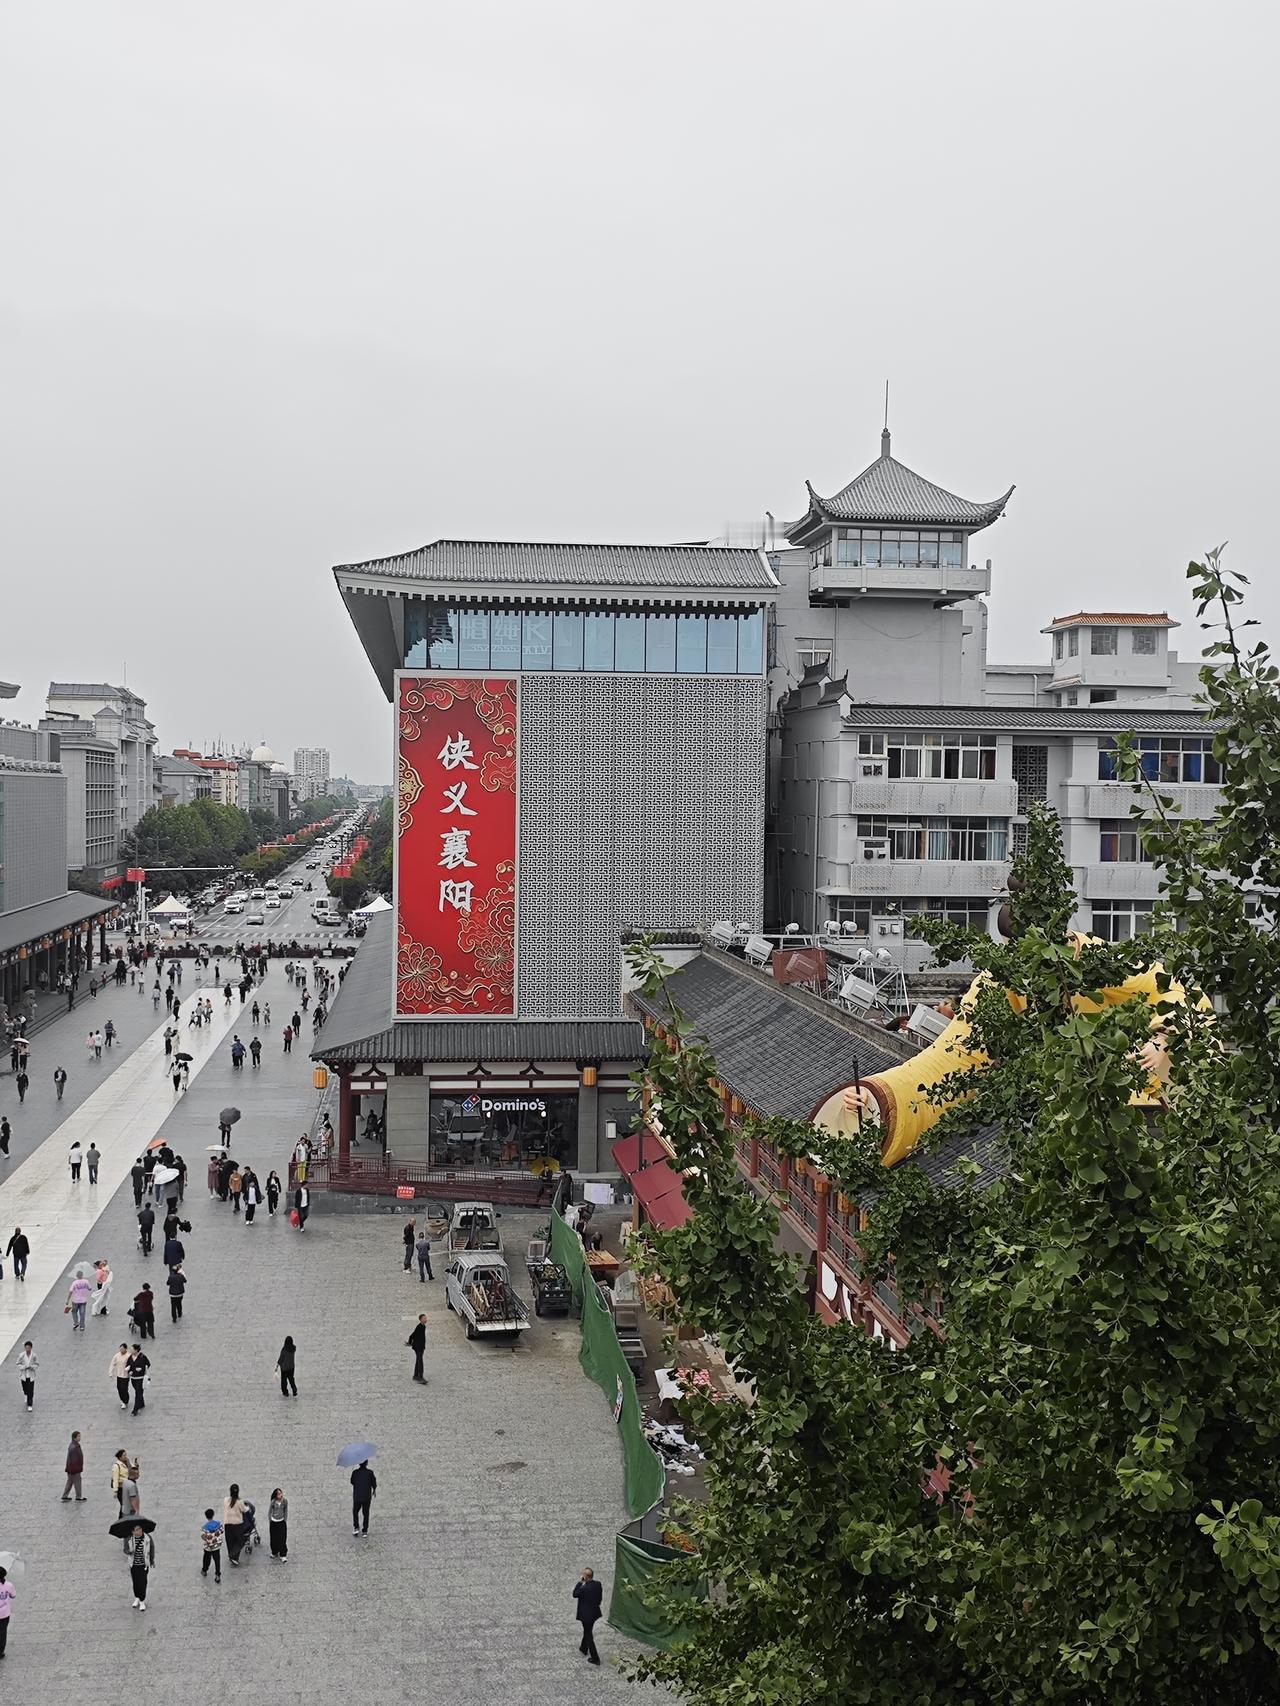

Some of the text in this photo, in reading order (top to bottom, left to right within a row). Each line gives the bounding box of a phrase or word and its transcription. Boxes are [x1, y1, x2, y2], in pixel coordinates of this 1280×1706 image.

[437, 731, 480, 913] 侠义襄阳
[481, 1097, 546, 1111] Domino's
